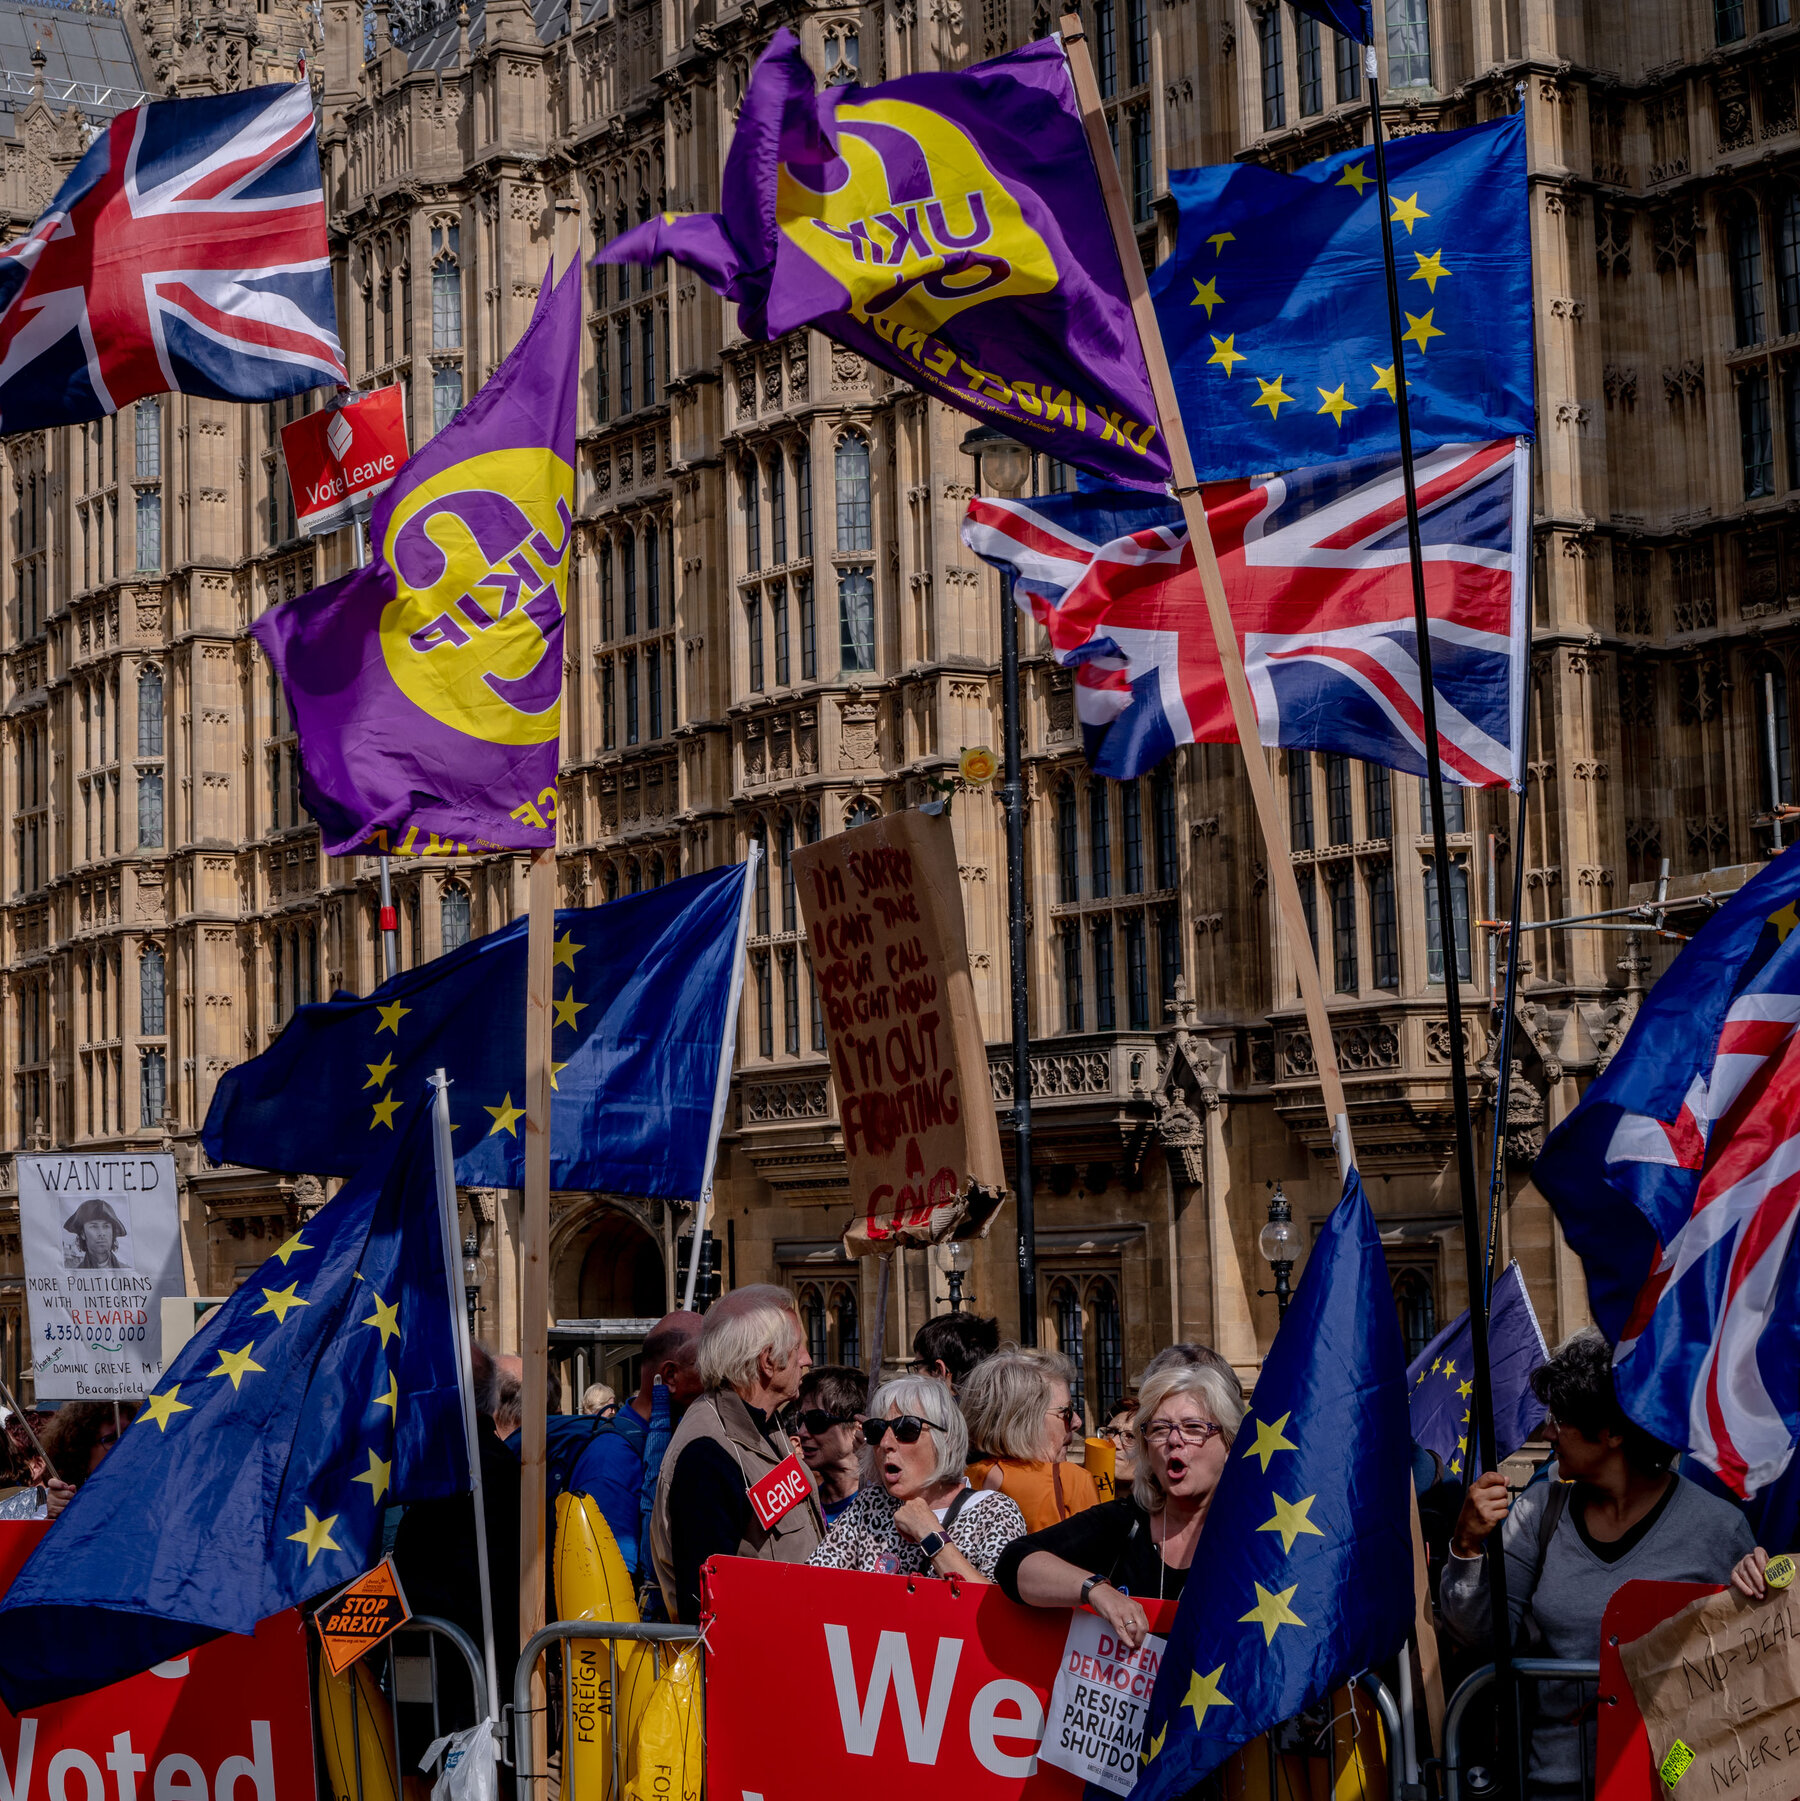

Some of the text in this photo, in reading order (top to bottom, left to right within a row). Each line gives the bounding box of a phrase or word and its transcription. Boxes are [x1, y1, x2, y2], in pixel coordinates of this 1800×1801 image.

[306, 454, 395, 505] Vote Leave
[848, 846, 913, 900] SORRY
[812, 919, 826, 960] I
[872, 893, 922, 930] TAKE
[817, 936, 929, 1000] YOUR CALL
[827, 973, 937, 1031] RIGHT NOW
[885, 1009, 941, 1086] OUT
[841, 1068, 960, 1157] FIGHTING
[36, 1160, 160, 1192] WANTED
[905, 1137, 926, 1179] A
[28, 1276, 152, 1292] MORE POLITICIANS
[43, 1295, 148, 1309] WITH INTEGRITY
[72, 1310, 148, 1325] REWARD
[35, 1353, 52, 1372] Thank
[53, 1363, 88, 1375] DOMINIC
[94, 1363, 131, 1375] GRIEVE
[76, 1382, 145, 1395] Beaconsfield
[753, 1468, 806, 1523] Leave
[325, 1615, 390, 1634] BREXIT
[341, 1597, 389, 1615] STOP
[1097, 1633, 1163, 1674] DEFEN
[1682, 1607, 1800, 1699] NO-DEAL
[578, 1650, 597, 1743] FOREIGN
[597, 1679, 614, 1716] AID
[823, 1622, 1045, 1779] We
[1074, 1683, 1139, 1725] RESIST
[1062, 1703, 1143, 1753] PARLIAM
[1060, 1727, 1135, 1774] SHUTDO
